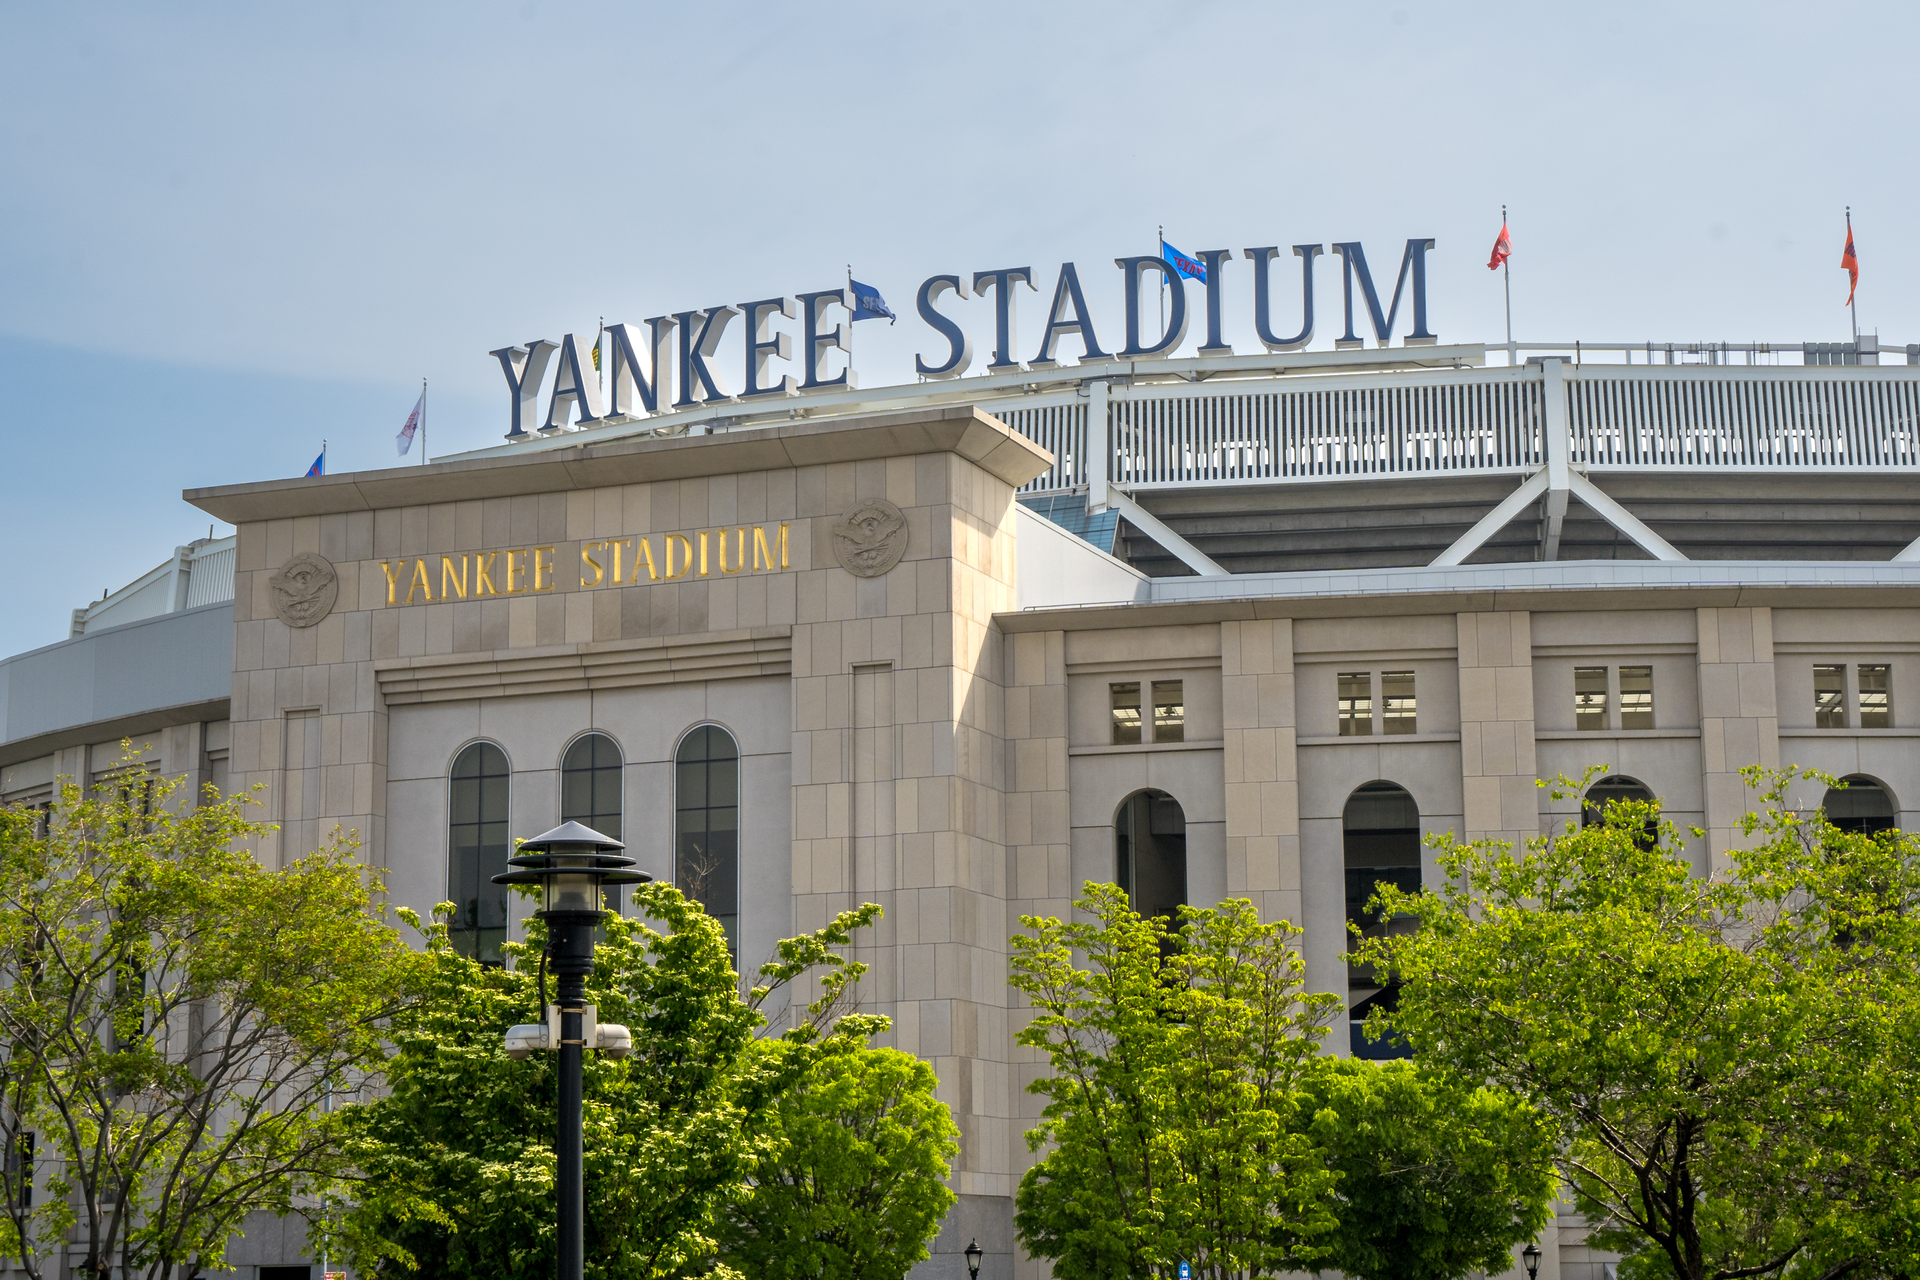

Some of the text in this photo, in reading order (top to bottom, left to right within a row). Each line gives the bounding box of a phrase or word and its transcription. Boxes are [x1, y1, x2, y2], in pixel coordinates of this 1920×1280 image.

[489, 237, 1437, 439] YANKEE STADIUM
[378, 523, 791, 606] YANKEE STADIUM
